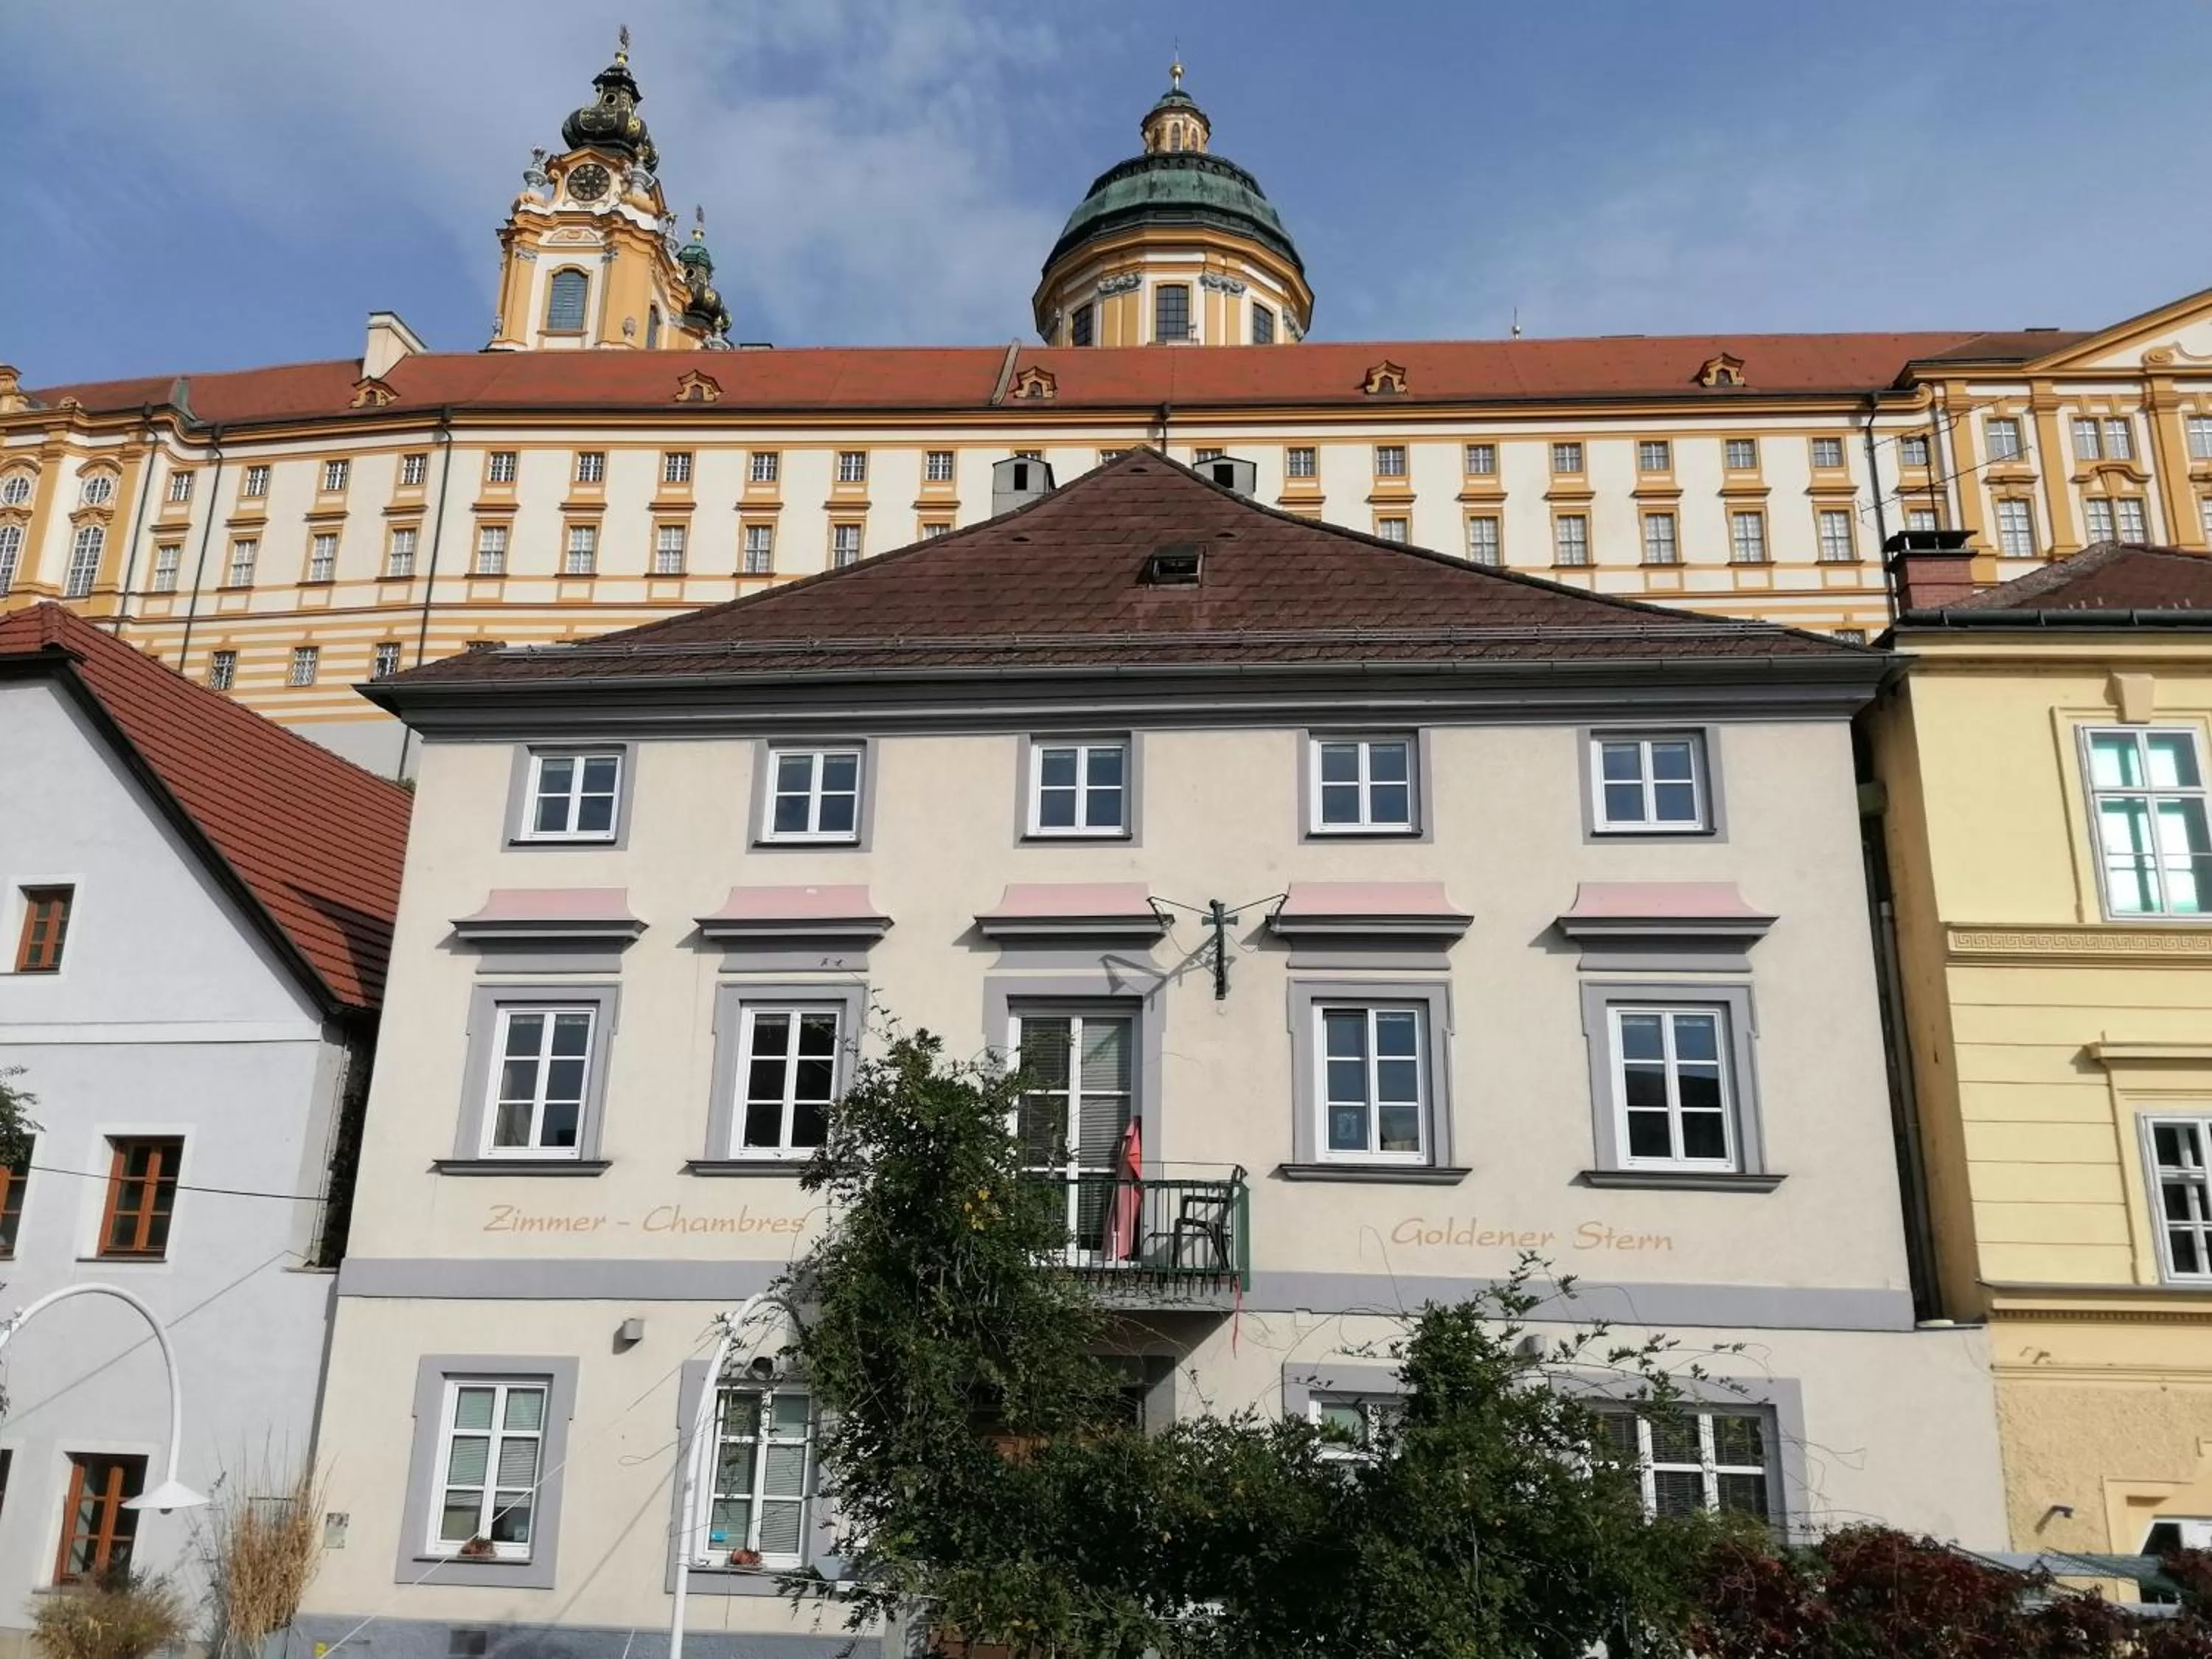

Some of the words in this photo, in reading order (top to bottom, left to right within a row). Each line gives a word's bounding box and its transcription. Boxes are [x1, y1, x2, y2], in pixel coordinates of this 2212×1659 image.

[483, 1204, 606, 1233] Zimmer
[642, 1205, 806, 1234] Chambres
[1391, 1217, 1556, 1248] Goldener
[1573, 1221, 1673, 1251] Stern
